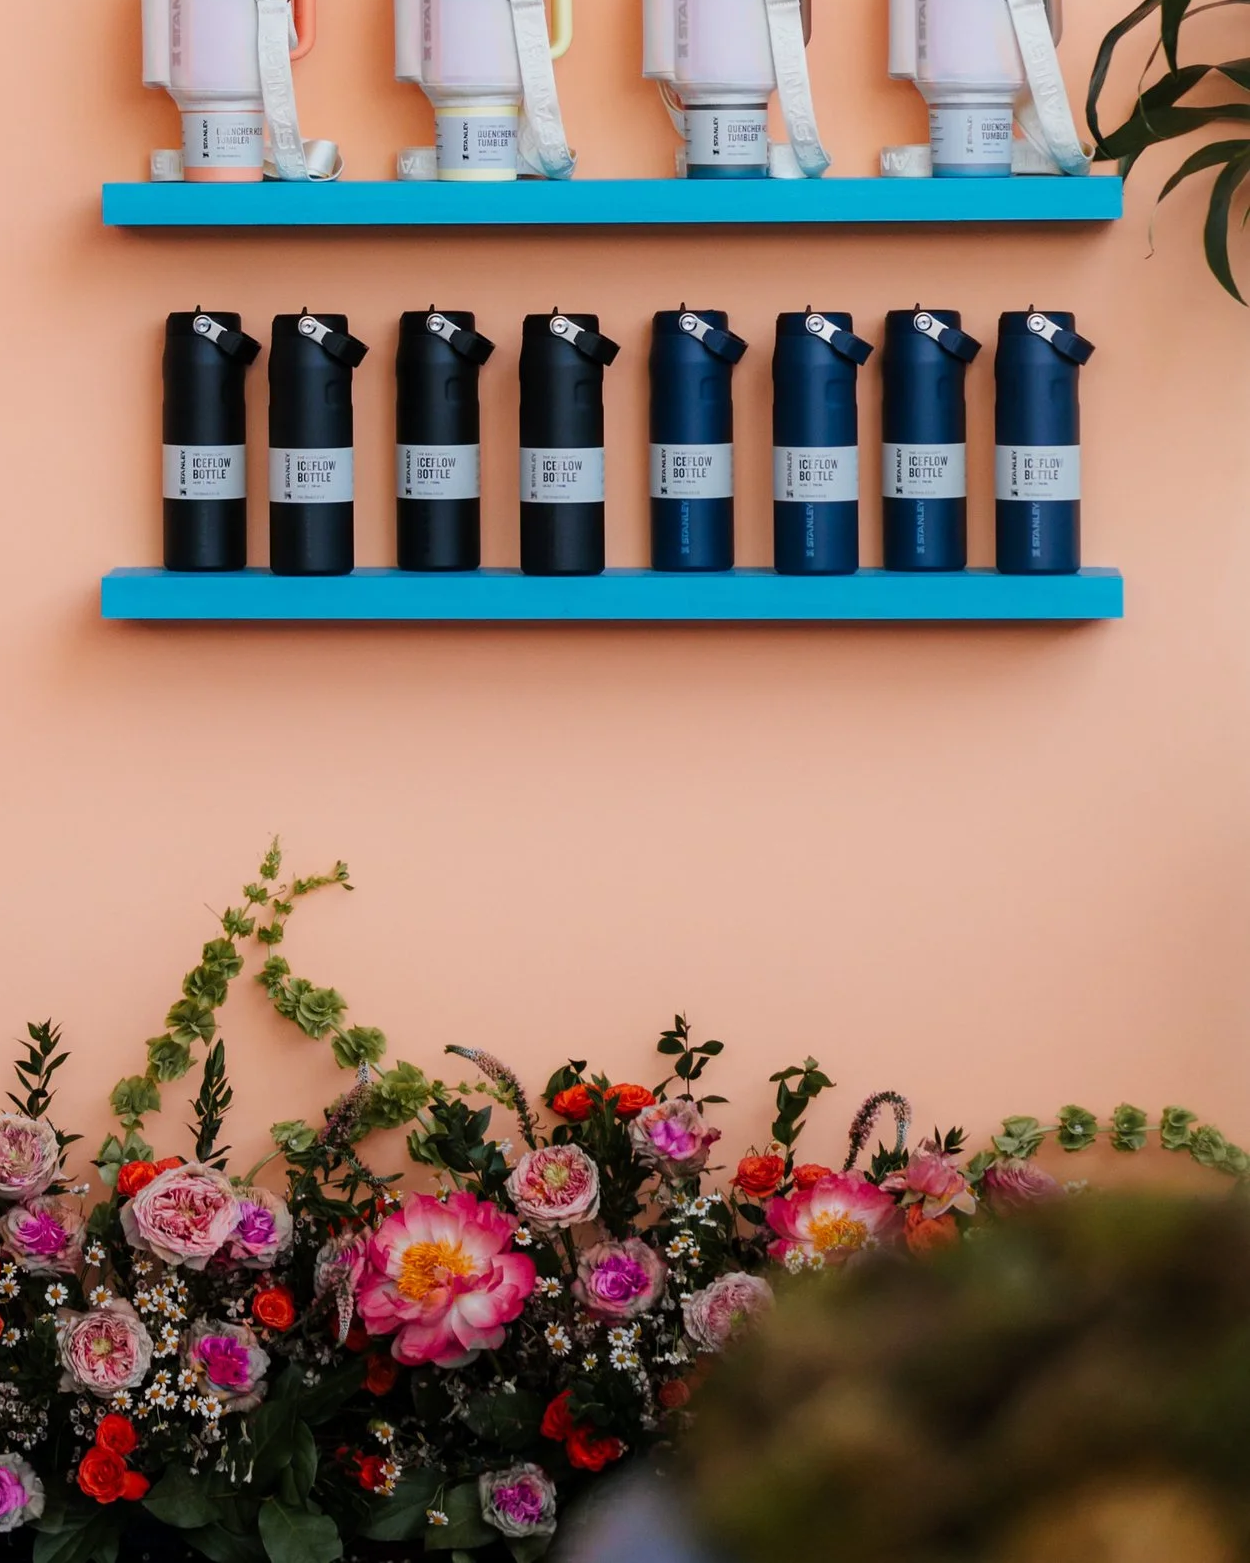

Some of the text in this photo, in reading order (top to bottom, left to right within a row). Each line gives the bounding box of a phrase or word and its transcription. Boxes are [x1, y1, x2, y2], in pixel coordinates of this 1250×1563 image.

[477, 129, 512, 138] QUENCHER
[727, 124, 762, 133] QUENCHER
[477, 138, 509, 147] TUMBLER
[727, 133, 759, 142] TUMBLER
[192, 457, 232, 468] ICEFLOW
[297, 460, 337, 471] ICEFLOW
[416, 457, 456, 468] ICEFLOW
[542, 460, 583, 471] ICELOW
[672, 456, 713, 467] ICEFLOW
[799, 459, 839, 470] ICEFLOW
[908, 456, 949, 467] ICEFLOW
[1024, 458, 1064, 469] ICFLOW
[192, 469, 227, 480] BOTTLE
[297, 472, 332, 483] BOTTLE
[417, 469, 451, 479] BOTTLE
[673, 467, 707, 478] BOTTLE
[799, 470, 834, 481] BOTTLE
[909, 467, 943, 478] BOTTLE
[681, 500, 690, 545] STANLEY
[806, 502, 814, 548] STANLEY
[916, 499, 925, 544] STANLEY
[1031, 501, 1040, 548] STANLEY
